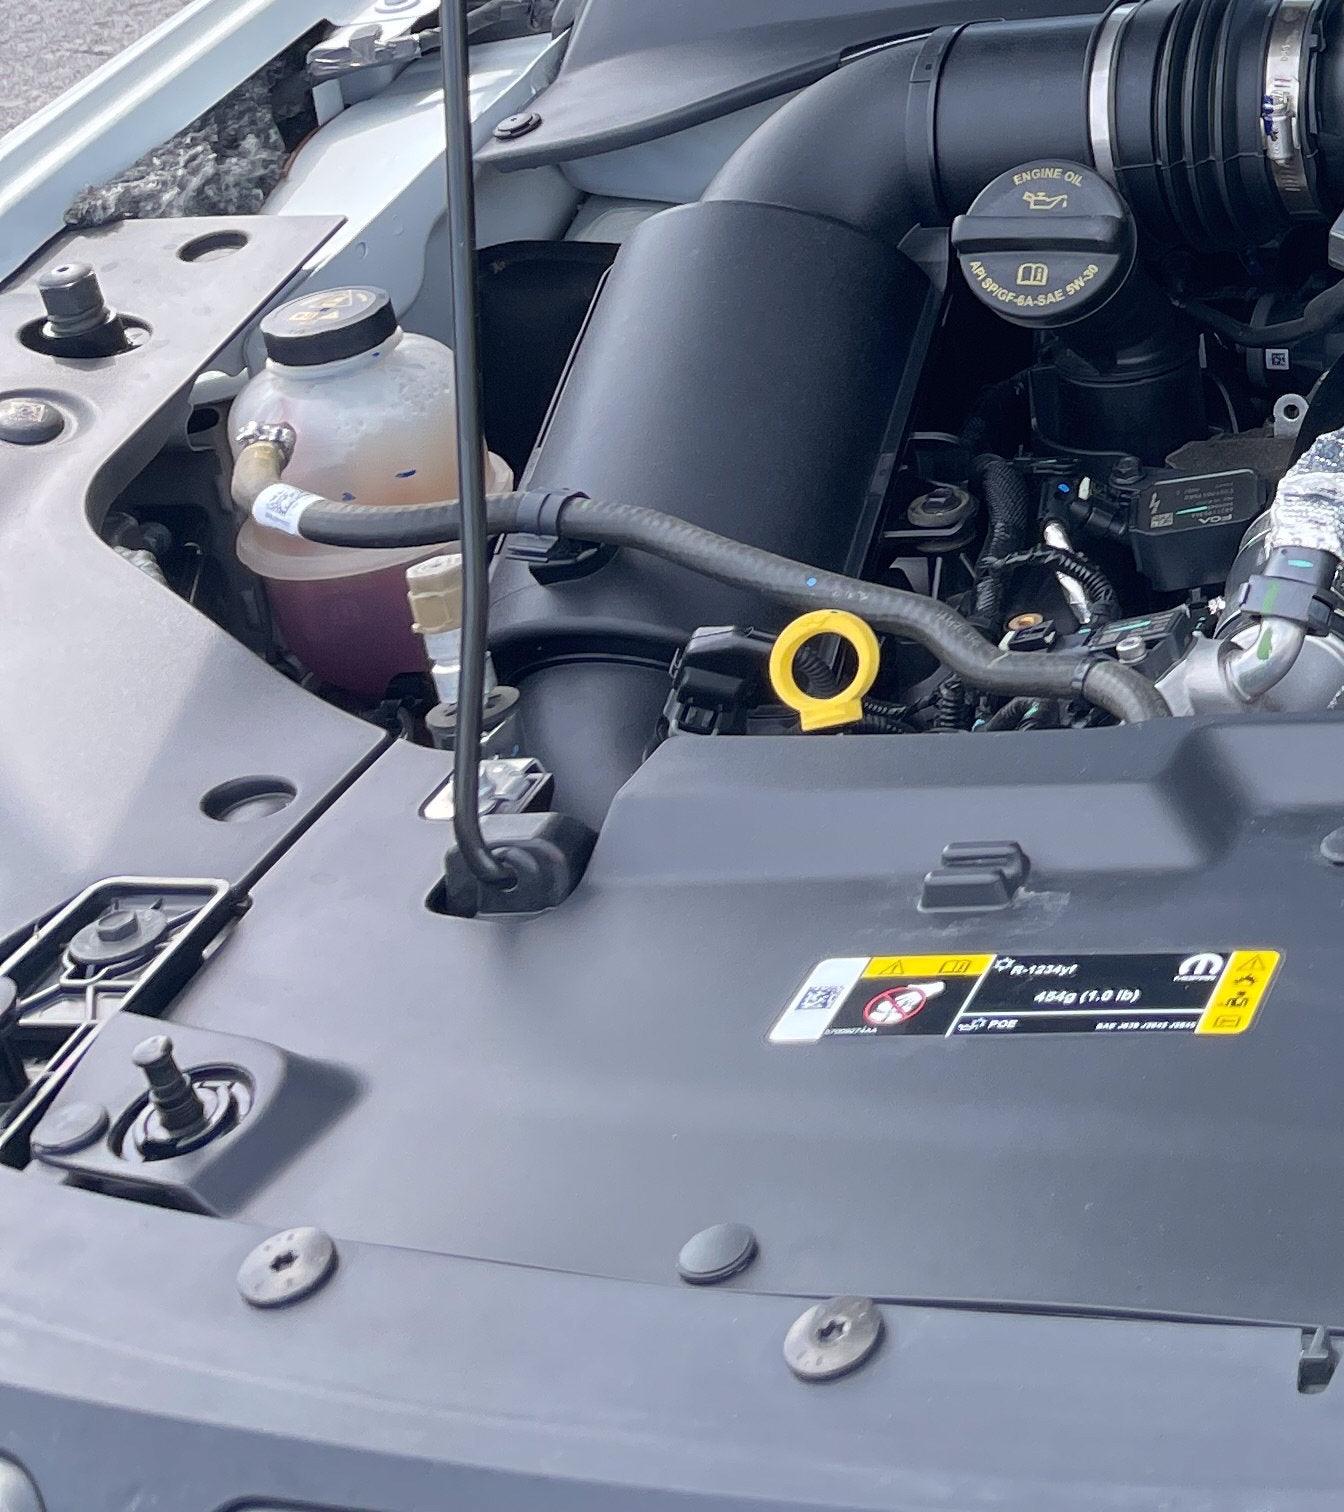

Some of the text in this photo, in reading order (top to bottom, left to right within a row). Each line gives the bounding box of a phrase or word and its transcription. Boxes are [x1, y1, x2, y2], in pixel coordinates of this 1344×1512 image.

[1012, 167, 1085, 188] ENGINE OIL
[969, 260, 988, 281] API
[1065, 264, 1099, 296] 5W-30
[1009, 963, 1079, 977] R-1234yf
[1033, 988, 1142, 1005] 454g (1.0 lb)
[987, 1019, 1019, 1029] POE
